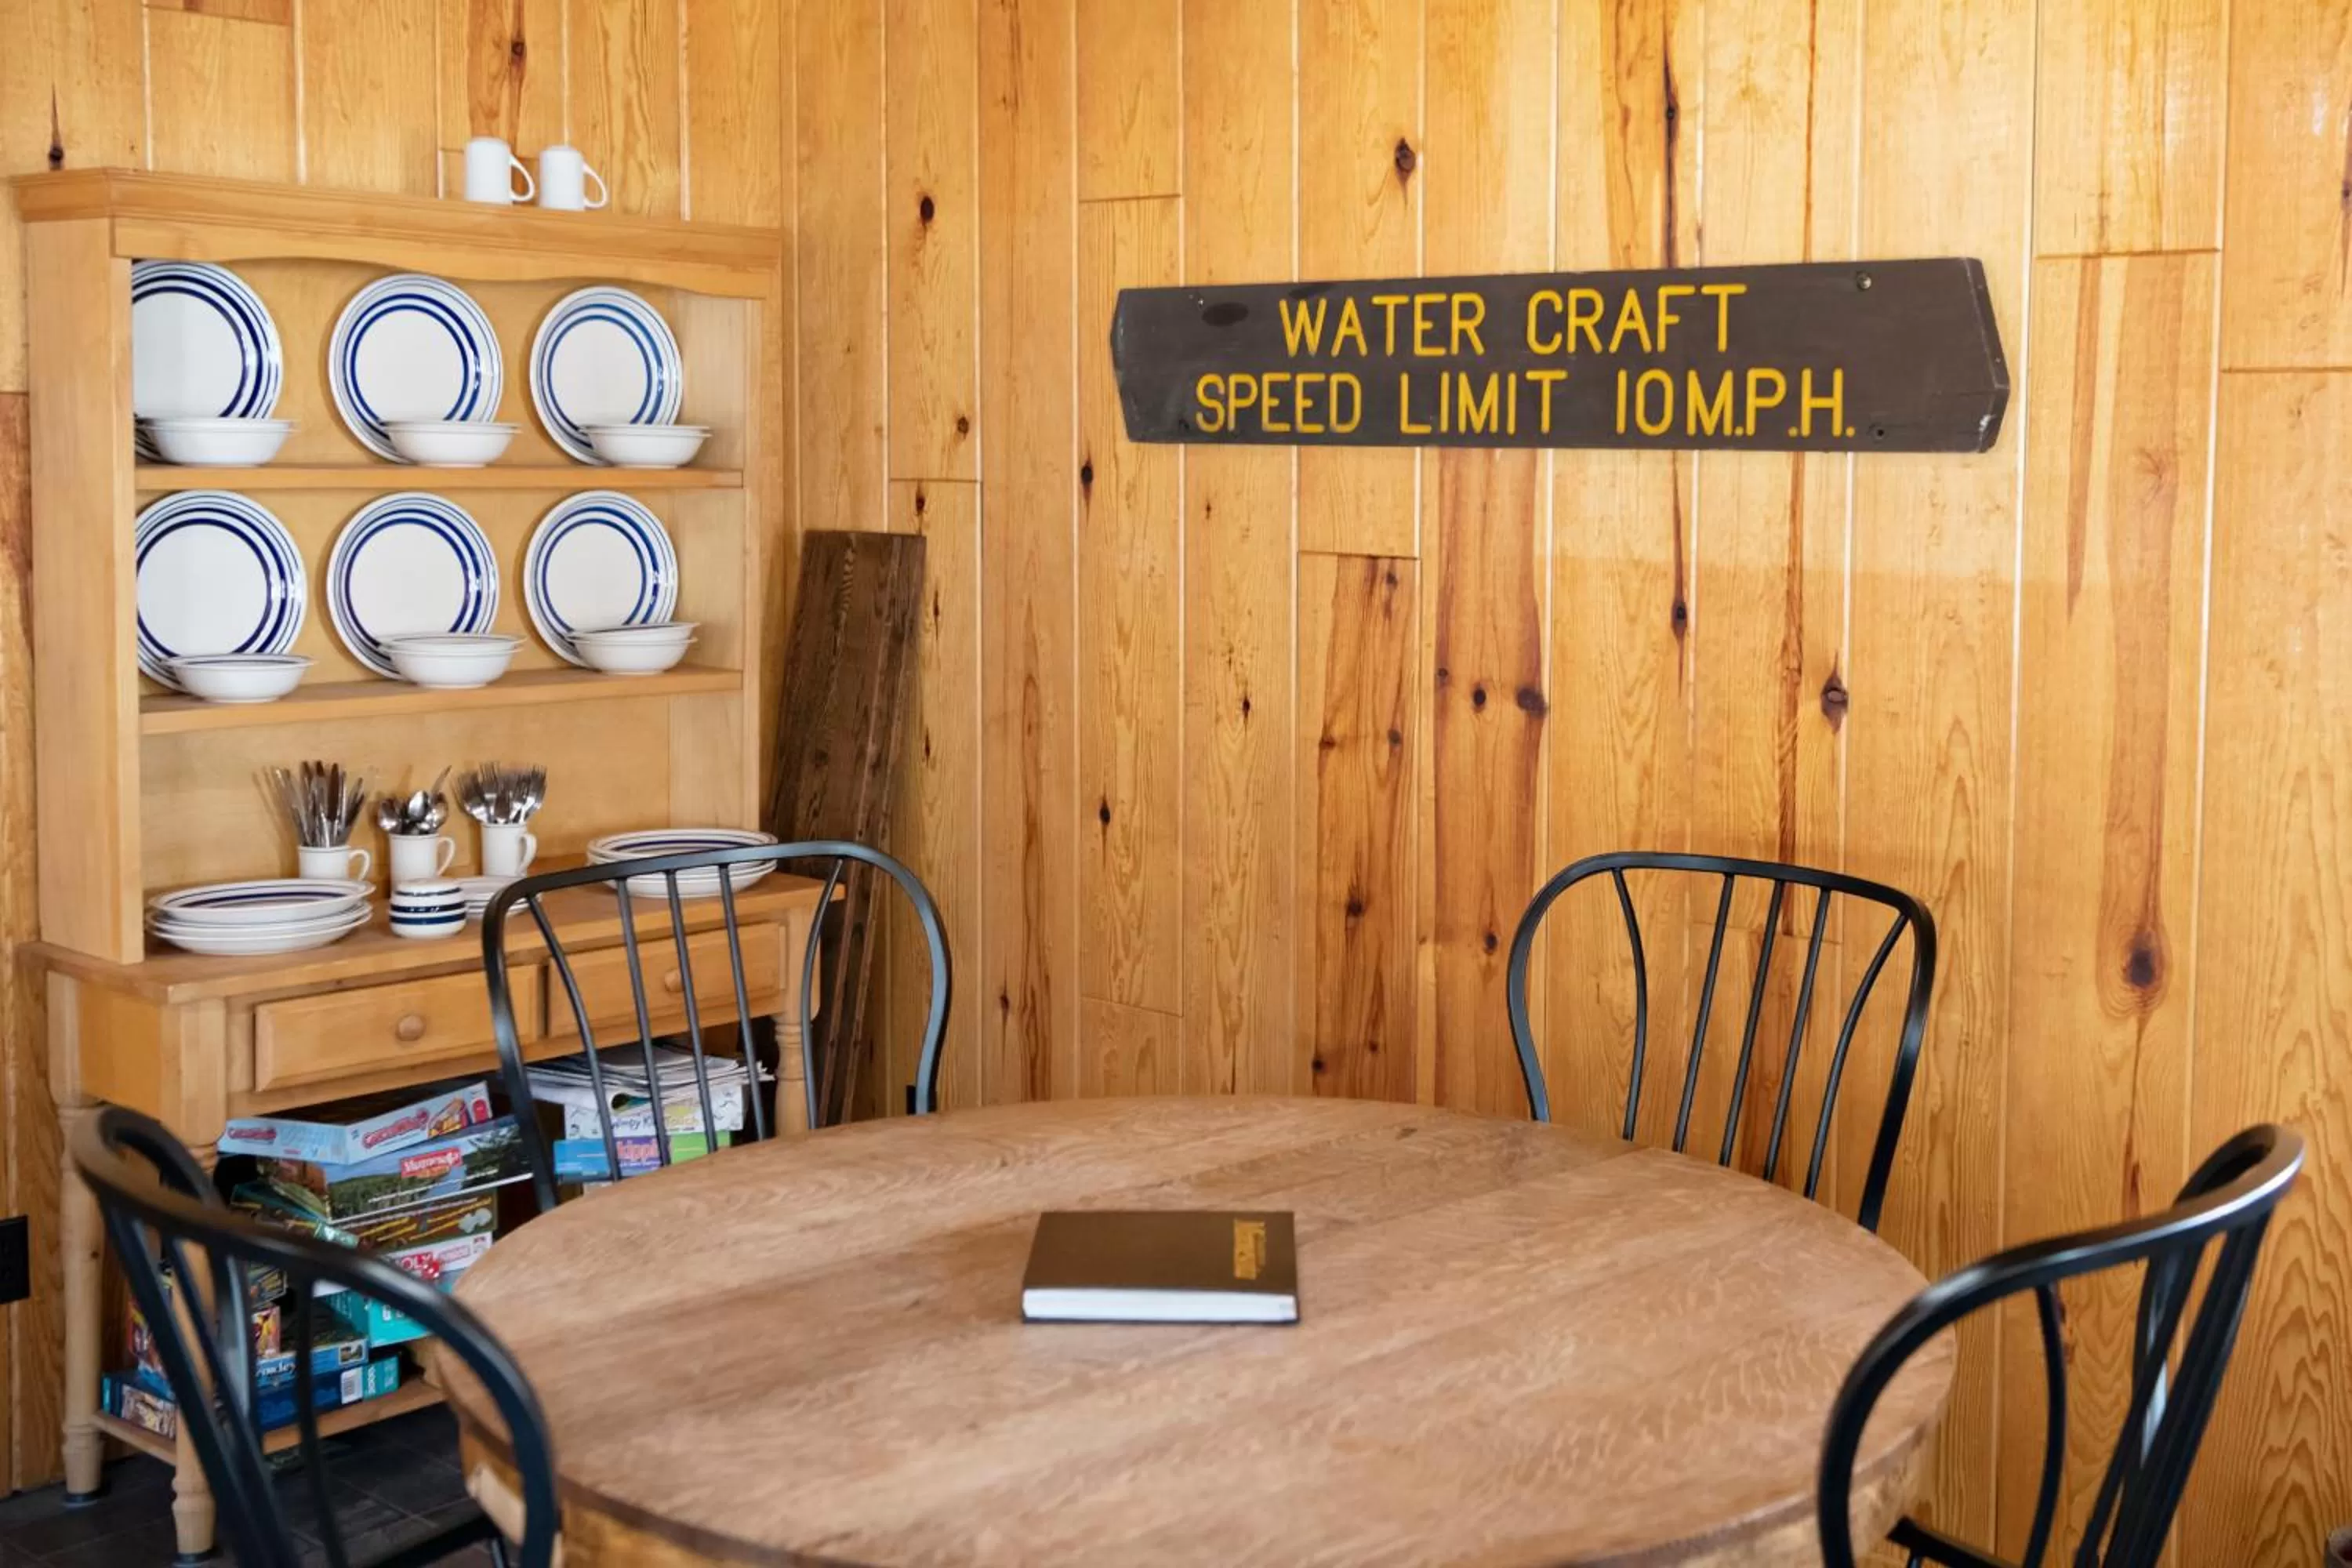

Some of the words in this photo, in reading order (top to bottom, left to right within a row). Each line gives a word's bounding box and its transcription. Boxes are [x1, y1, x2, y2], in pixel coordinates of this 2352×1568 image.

[1279, 292, 1486, 358] WATER
[1526, 282, 1749, 357] CRAFT
[1196, 371, 1363, 434] SPEED
[1399, 368, 1569, 437] LIMIT
